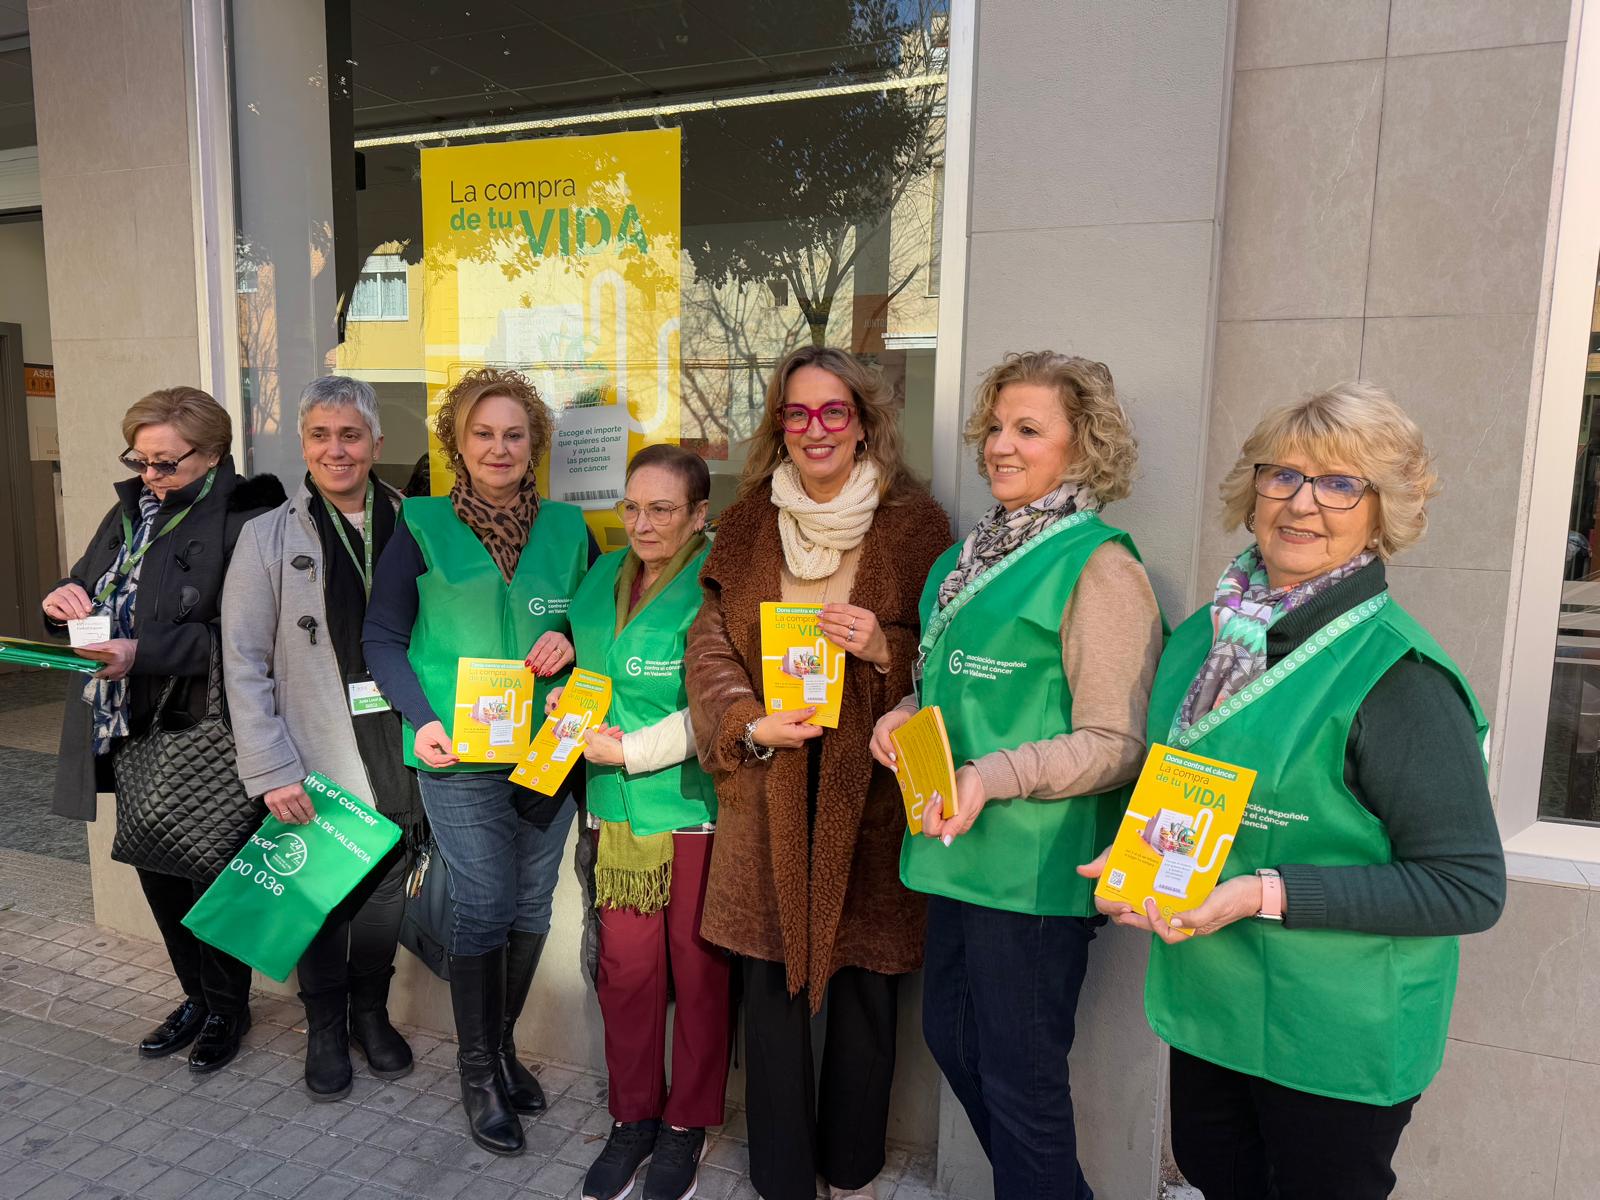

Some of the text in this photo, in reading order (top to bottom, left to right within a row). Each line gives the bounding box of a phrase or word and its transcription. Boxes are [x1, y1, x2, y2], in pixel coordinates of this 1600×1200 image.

[450, 178, 576, 204] La compra
[450, 204, 648, 257] de tu VIDA
[558, 428, 584, 438] Escoge
[593, 426, 622, 436] importe
[558, 435, 622, 448] que quieres donar
[572, 448, 577, 456] y
[578, 446, 600, 456] ayuda
[578, 455, 610, 466] personas
[582, 464, 608, 473] cáncer
[798, 624, 824, 637] VID
[996, 660, 1027, 668] española
[969, 670, 996, 680] Valencia
[490, 678, 522, 688] VIDA
[1159, 762, 1210, 785] La compra
[1165, 754, 1182, 764] Dona
[1183, 760, 1205, 770] contra
[1212, 767, 1236, 780] cáncer
[1156, 772, 1226, 812] de tu VIDA
[326, 789, 341, 799] el
[339, 796, 379, 826] cáncer
[1259, 814, 1289, 826] cáncer
[1268, 809, 1309, 822] española
[322, 821, 335, 834] DE
[334, 829, 372, 864] VALENCIA
[254, 870, 284, 896] 036
